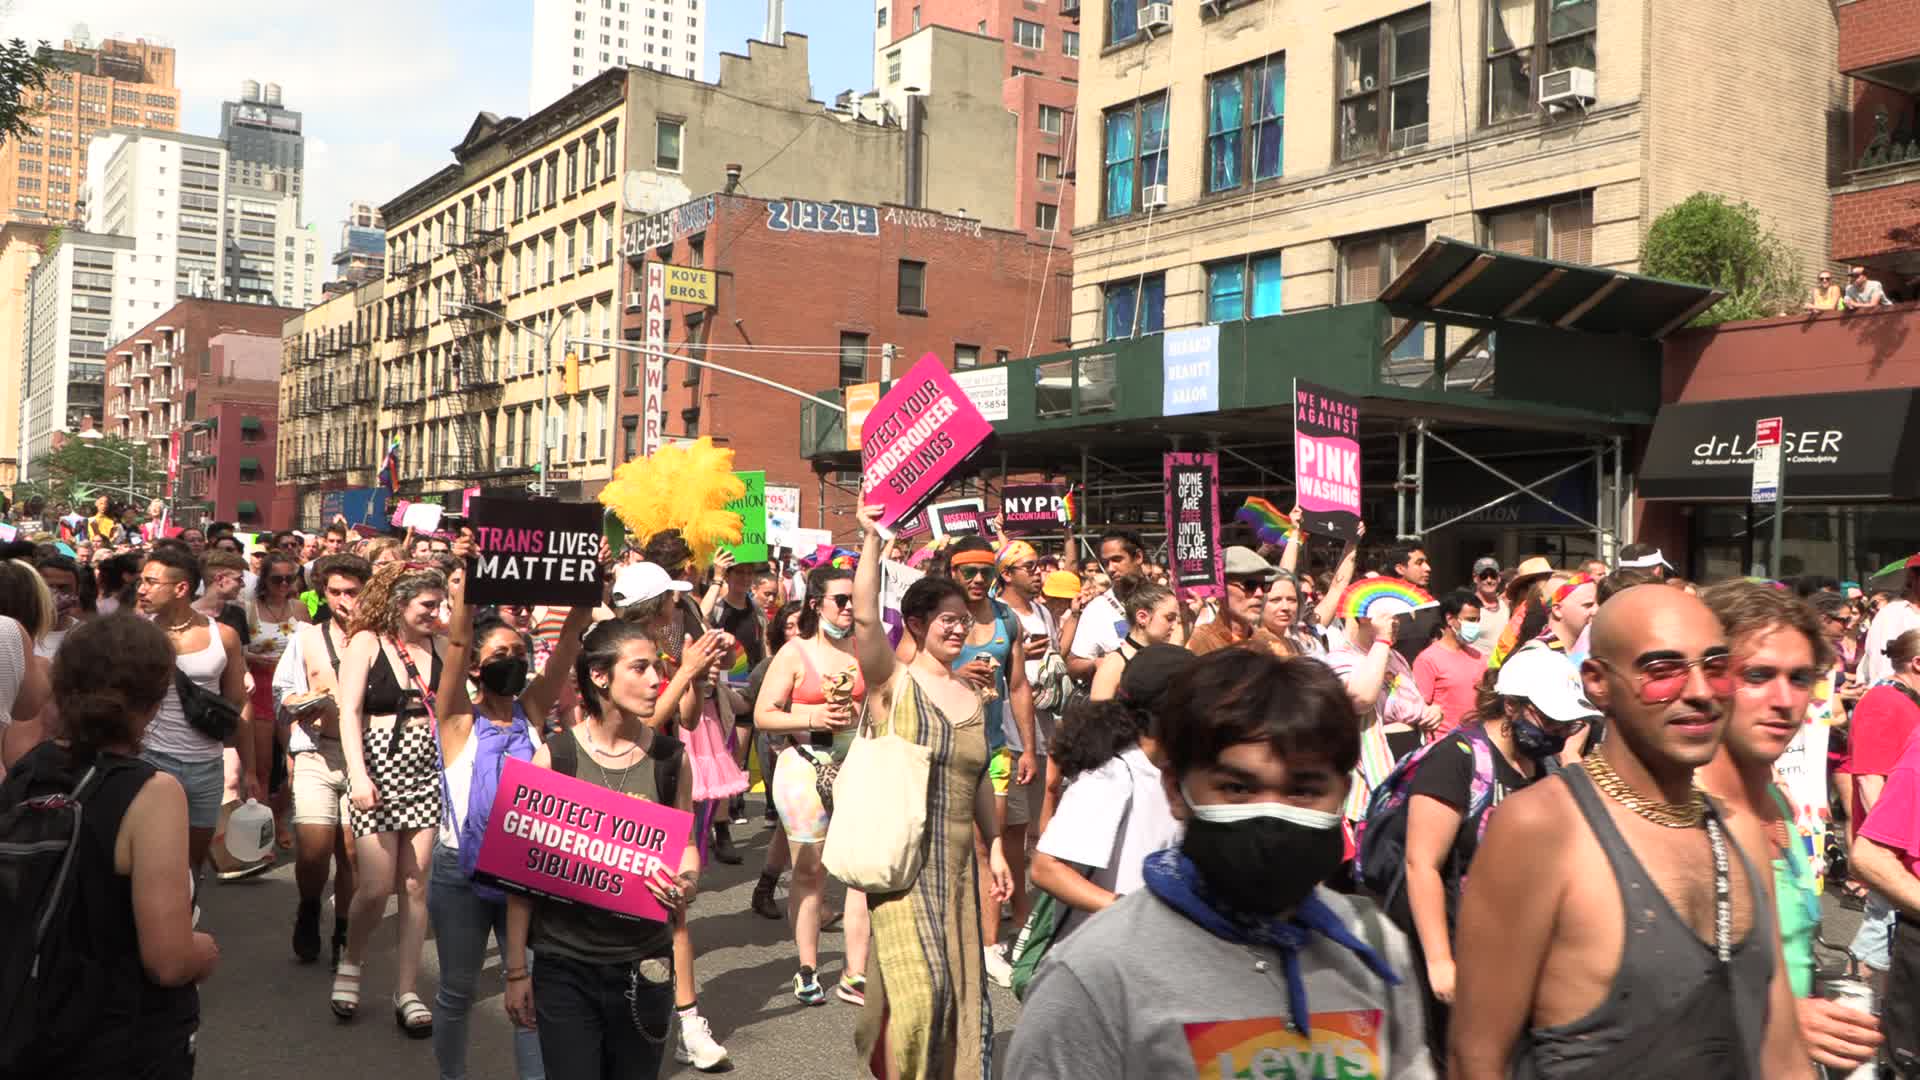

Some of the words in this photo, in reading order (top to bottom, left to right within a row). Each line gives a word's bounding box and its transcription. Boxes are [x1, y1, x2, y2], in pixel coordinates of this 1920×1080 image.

[671, 269, 707, 284] KOVE
[900, 379, 944, 421] YOUR
[1298, 391, 1315, 408] WE
[1320, 396, 1358, 420] MARCH
[1298, 406, 1358, 436] AGAINST
[889, 431, 956, 495] SIBLINGS
[1299, 437, 1359, 488] PINK
[1178, 472, 1203, 486] NONE
[1178, 485, 1191, 498] OF
[1191, 485, 1204, 498] US
[1299, 474, 1359, 508] WASHING
[1005, 496, 1063, 514] NYPD
[1180, 510, 1203, 522] FREE
[1182, 498, 1199, 510] ARE
[478, 527, 545, 554] TRANS
[548, 530, 599, 556] LIVES
[1177, 535, 1192, 548] ALL
[1194, 534, 1206, 547] OF
[1178, 522, 1204, 535] UNTIL
[1177, 547, 1188, 560] US
[1189, 546, 1208, 560] ARE
[1181, 559, 1204, 572] FREE
[476, 555, 597, 582] MATTER
[513, 784, 608, 835] PROTECT
[611, 815, 668, 854] YOUR
[503, 810, 662, 878] GENDERQUEER
[526, 847, 625, 896] SIBLINGS
